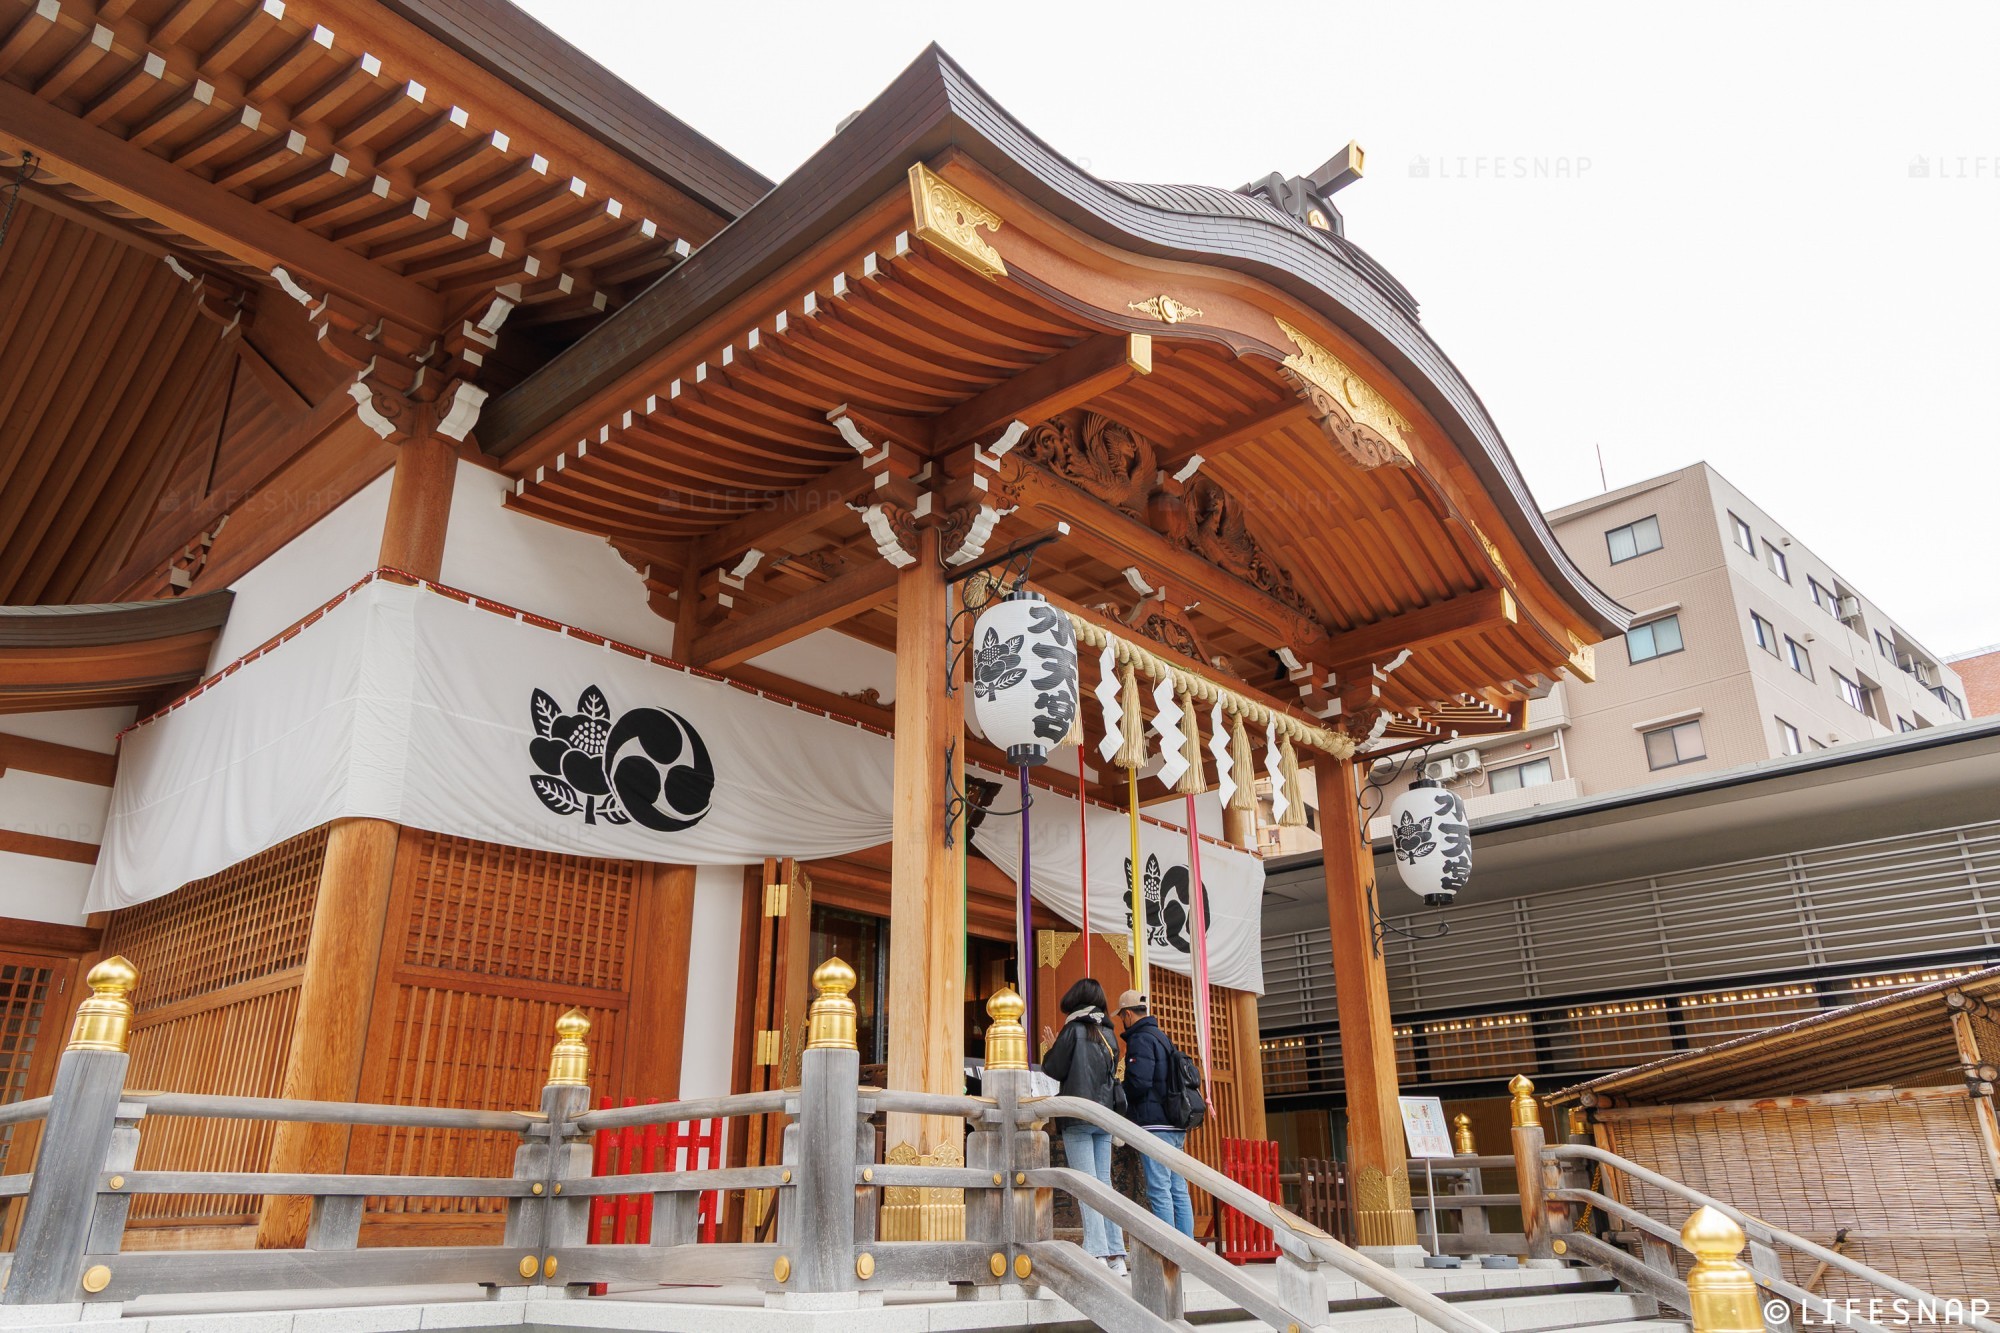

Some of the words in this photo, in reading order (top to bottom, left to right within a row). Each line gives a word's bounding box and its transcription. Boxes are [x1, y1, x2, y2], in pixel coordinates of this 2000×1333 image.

[1027, 603, 1078, 744] 水天宮
[1434, 790, 1473, 893] 水天宮
